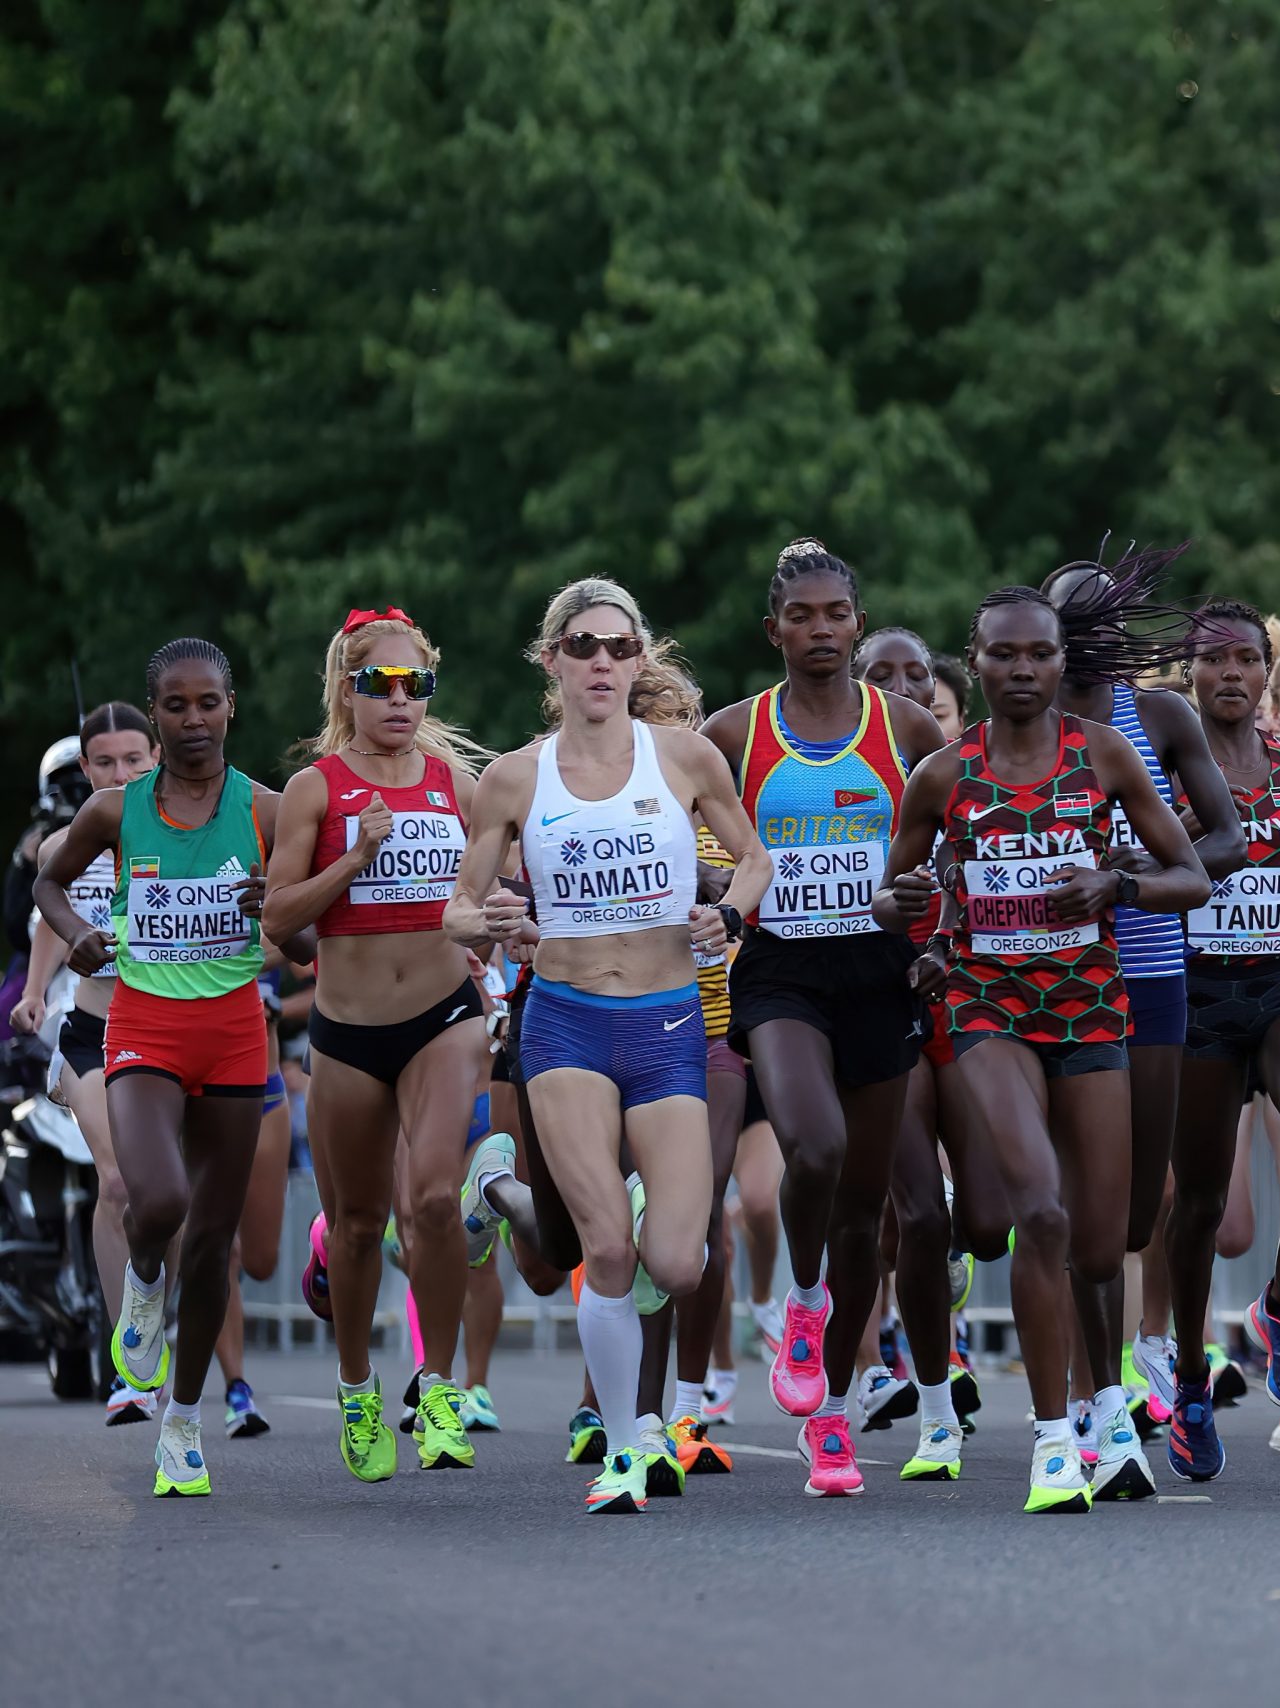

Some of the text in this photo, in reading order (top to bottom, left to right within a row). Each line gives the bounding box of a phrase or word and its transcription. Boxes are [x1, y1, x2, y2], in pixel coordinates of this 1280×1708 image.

[401, 819, 450, 840] QNB
[766, 814, 886, 845] ERITREA
[593, 833, 655, 861] QNB
[975, 829, 1087, 860] KENYA
[810, 851, 869, 875] QNB
[552, 861, 668, 899] D'AMATO
[177, 884, 233, 906] QNB
[372, 884, 447, 901] OREGON22
[775, 879, 873, 912] WELDU
[572, 902, 661, 923] OREGON22
[134, 910, 244, 940] YESHANEH
[781, 918, 870, 938] OREGON22
[991, 931, 1081, 951] OREGON22
[149, 946, 231, 962] OREGON22
